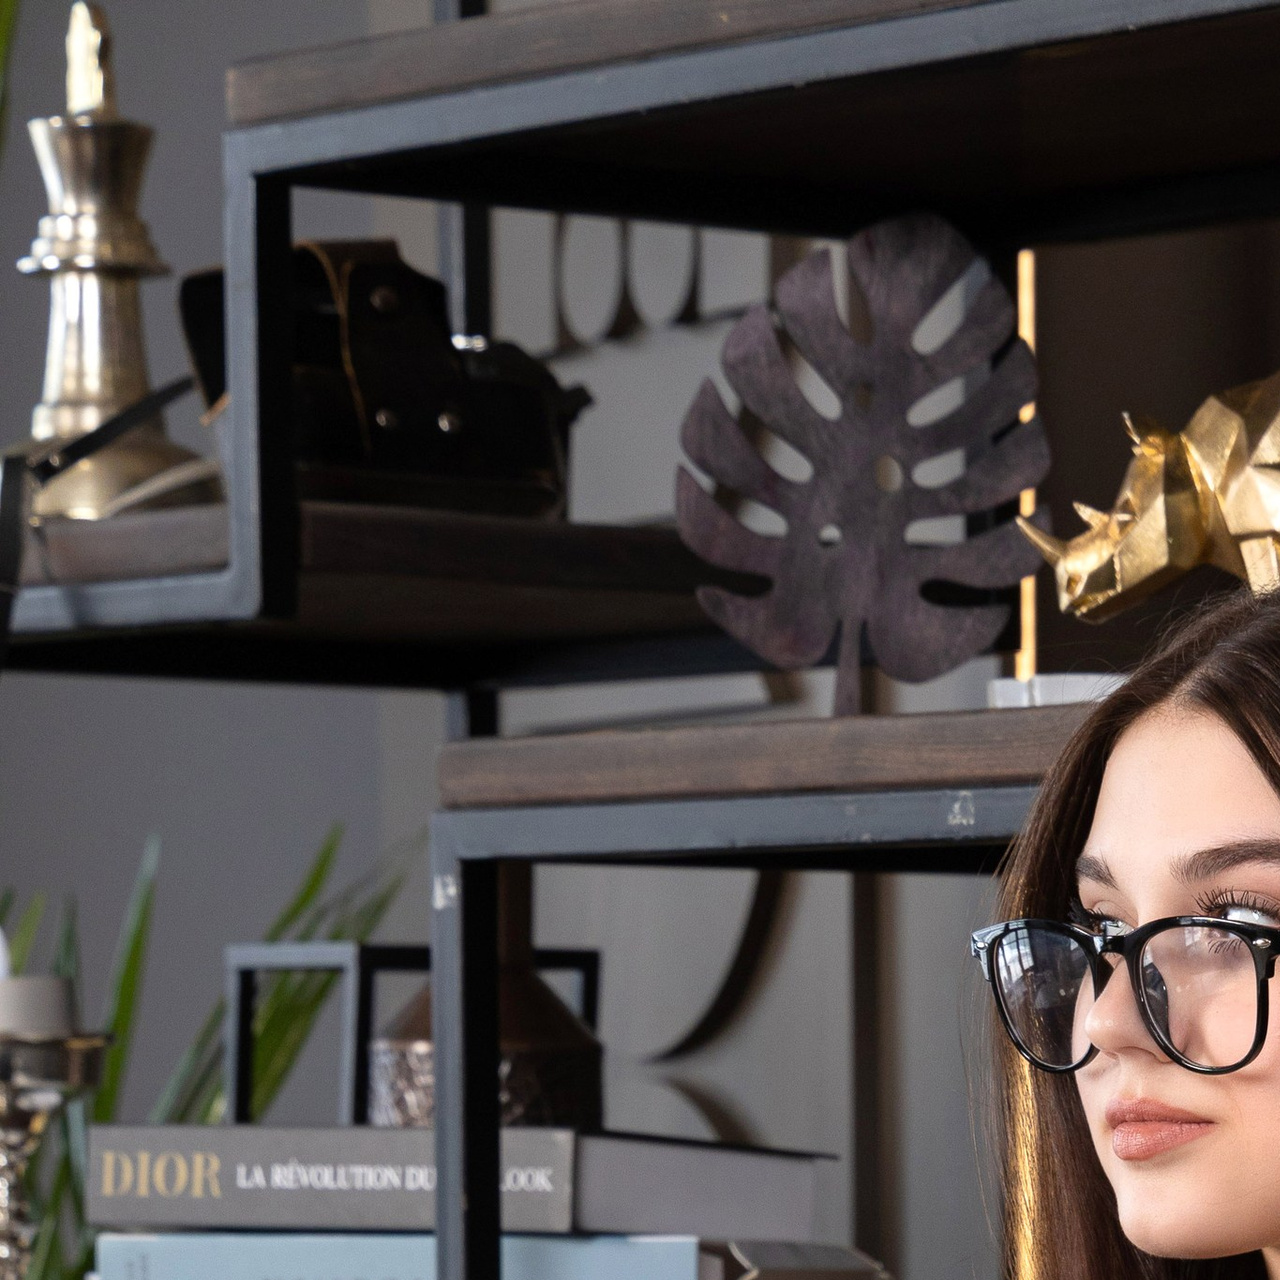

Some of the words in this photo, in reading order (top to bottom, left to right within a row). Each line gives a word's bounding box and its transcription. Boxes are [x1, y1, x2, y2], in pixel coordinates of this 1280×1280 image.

[101, 1149, 222, 1198] DIOR
[236, 1163, 267, 1190] LA
[270, 1156, 402, 1191] RÉVOLUTION
[404, 1164, 437, 1191] DU
[500, 1166, 554, 1192] OOK
